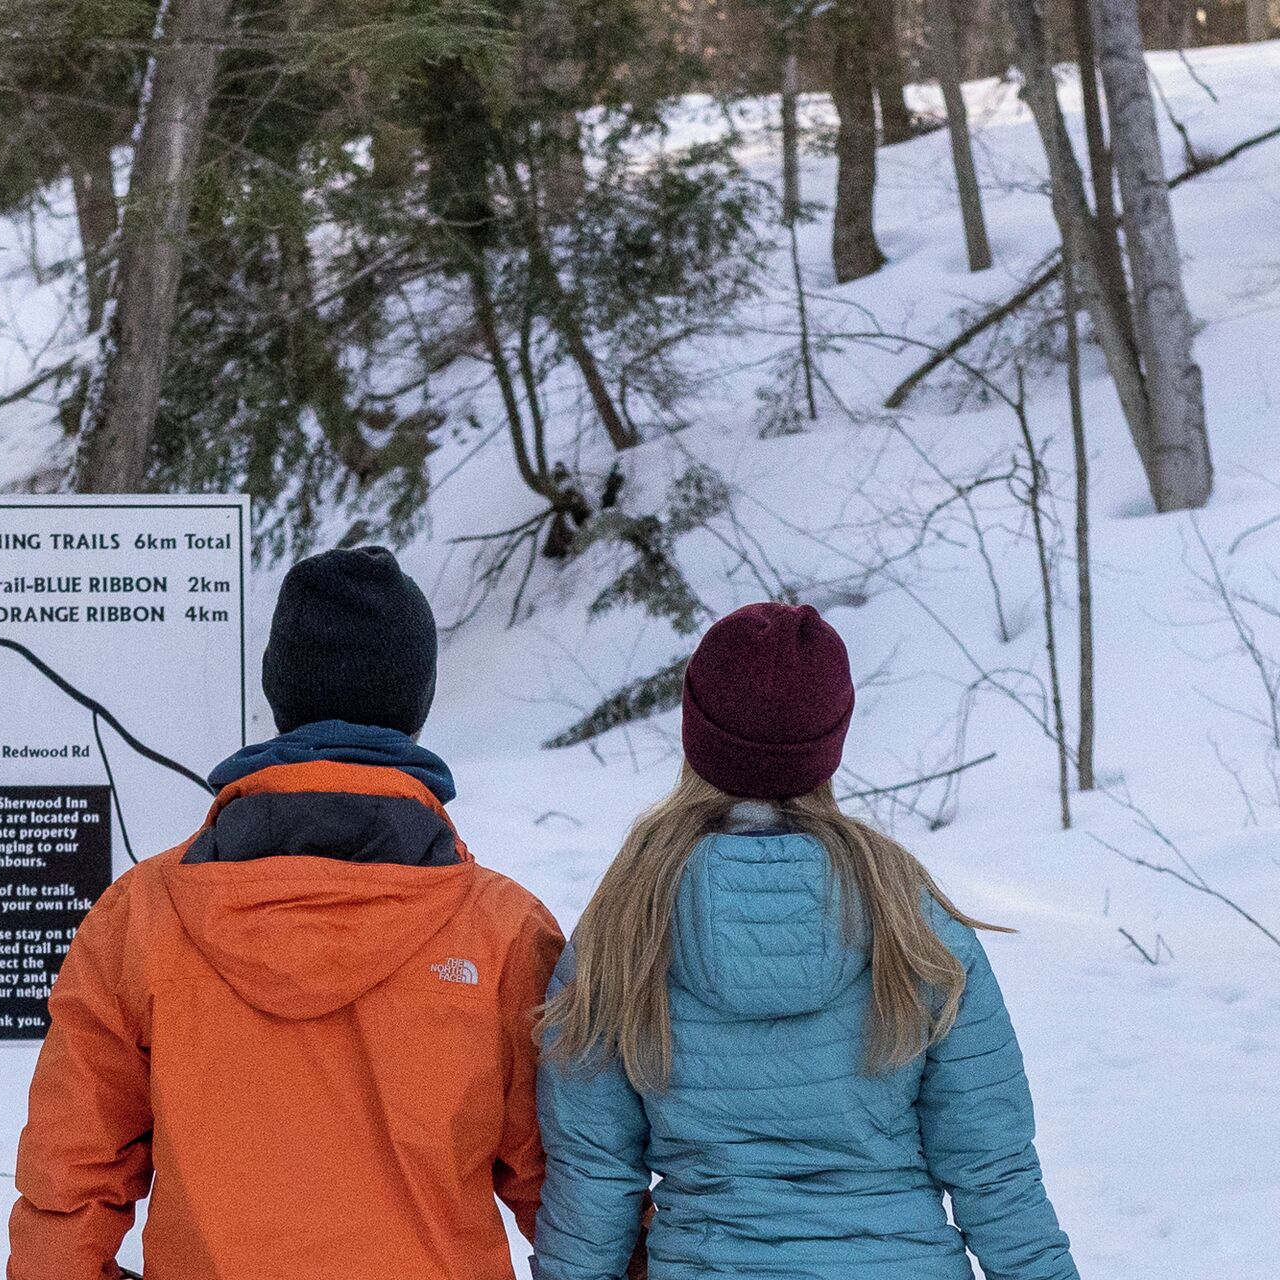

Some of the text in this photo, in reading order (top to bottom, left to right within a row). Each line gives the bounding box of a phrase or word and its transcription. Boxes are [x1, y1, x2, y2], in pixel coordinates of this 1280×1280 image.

[50, 534, 120, 550] TRAILS
[134, 534, 176, 550] 6km
[184, 534, 230, 550] Total
[90, 576, 166, 592] RIBBON
[188, 576, 230, 592] 2km
[86, 606, 164, 622] RIBBON
[184, 606, 228, 622] 4km
[2, 744, 90, 758] Redwood Rd
[66, 796, 88, 808] Inn
[6, 814, 28, 824] are
[30, 812, 78, 824] located
[82, 814, 100, 822] on
[20, 828, 76, 840] property
[38, 842, 52, 852] to
[56, 842, 78, 852] our
[16, 884, 38, 896] the
[42, 884, 74, 896] trails
[2, 902, 32, 912] your
[36, 902, 64, 910] own
[16, 930, 42, 942] stay
[46, 930, 62, 940] on
[24, 942, 52, 954] trail
[55, 944, 71, 954] an
[22, 956, 44, 968] the
[448, 958, 464, 967] THE
[430, 963, 463, 974] NORTH
[24, 970, 46, 982] and
[439, 973, 462, 982] FACE
[18, 1018, 44, 1028] you.
